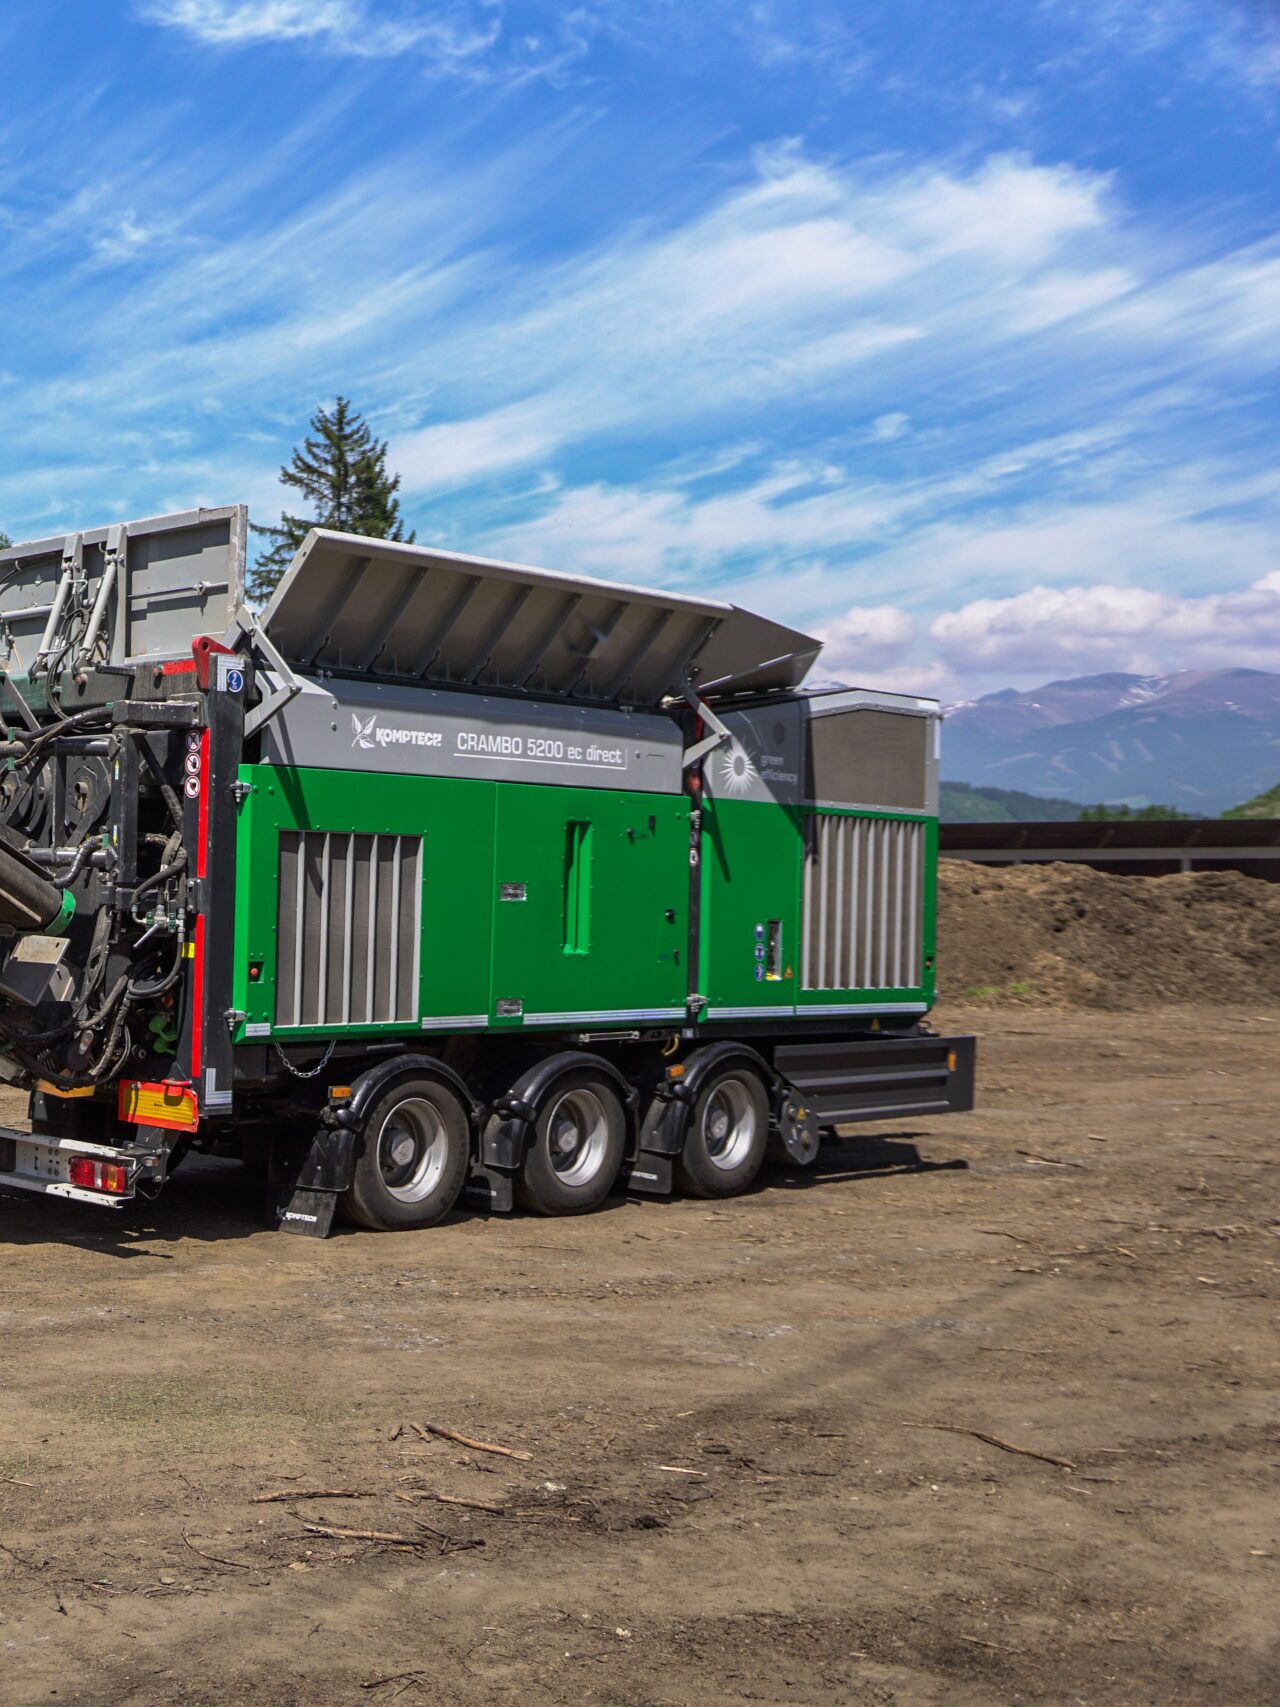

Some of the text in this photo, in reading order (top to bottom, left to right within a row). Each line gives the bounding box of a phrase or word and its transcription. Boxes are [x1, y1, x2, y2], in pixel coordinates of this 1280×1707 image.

[376, 728, 443, 747] KOMPTECH
[457, 732, 622, 763] CRAMBO 5200 ec direct
[761, 755, 784, 767] green
